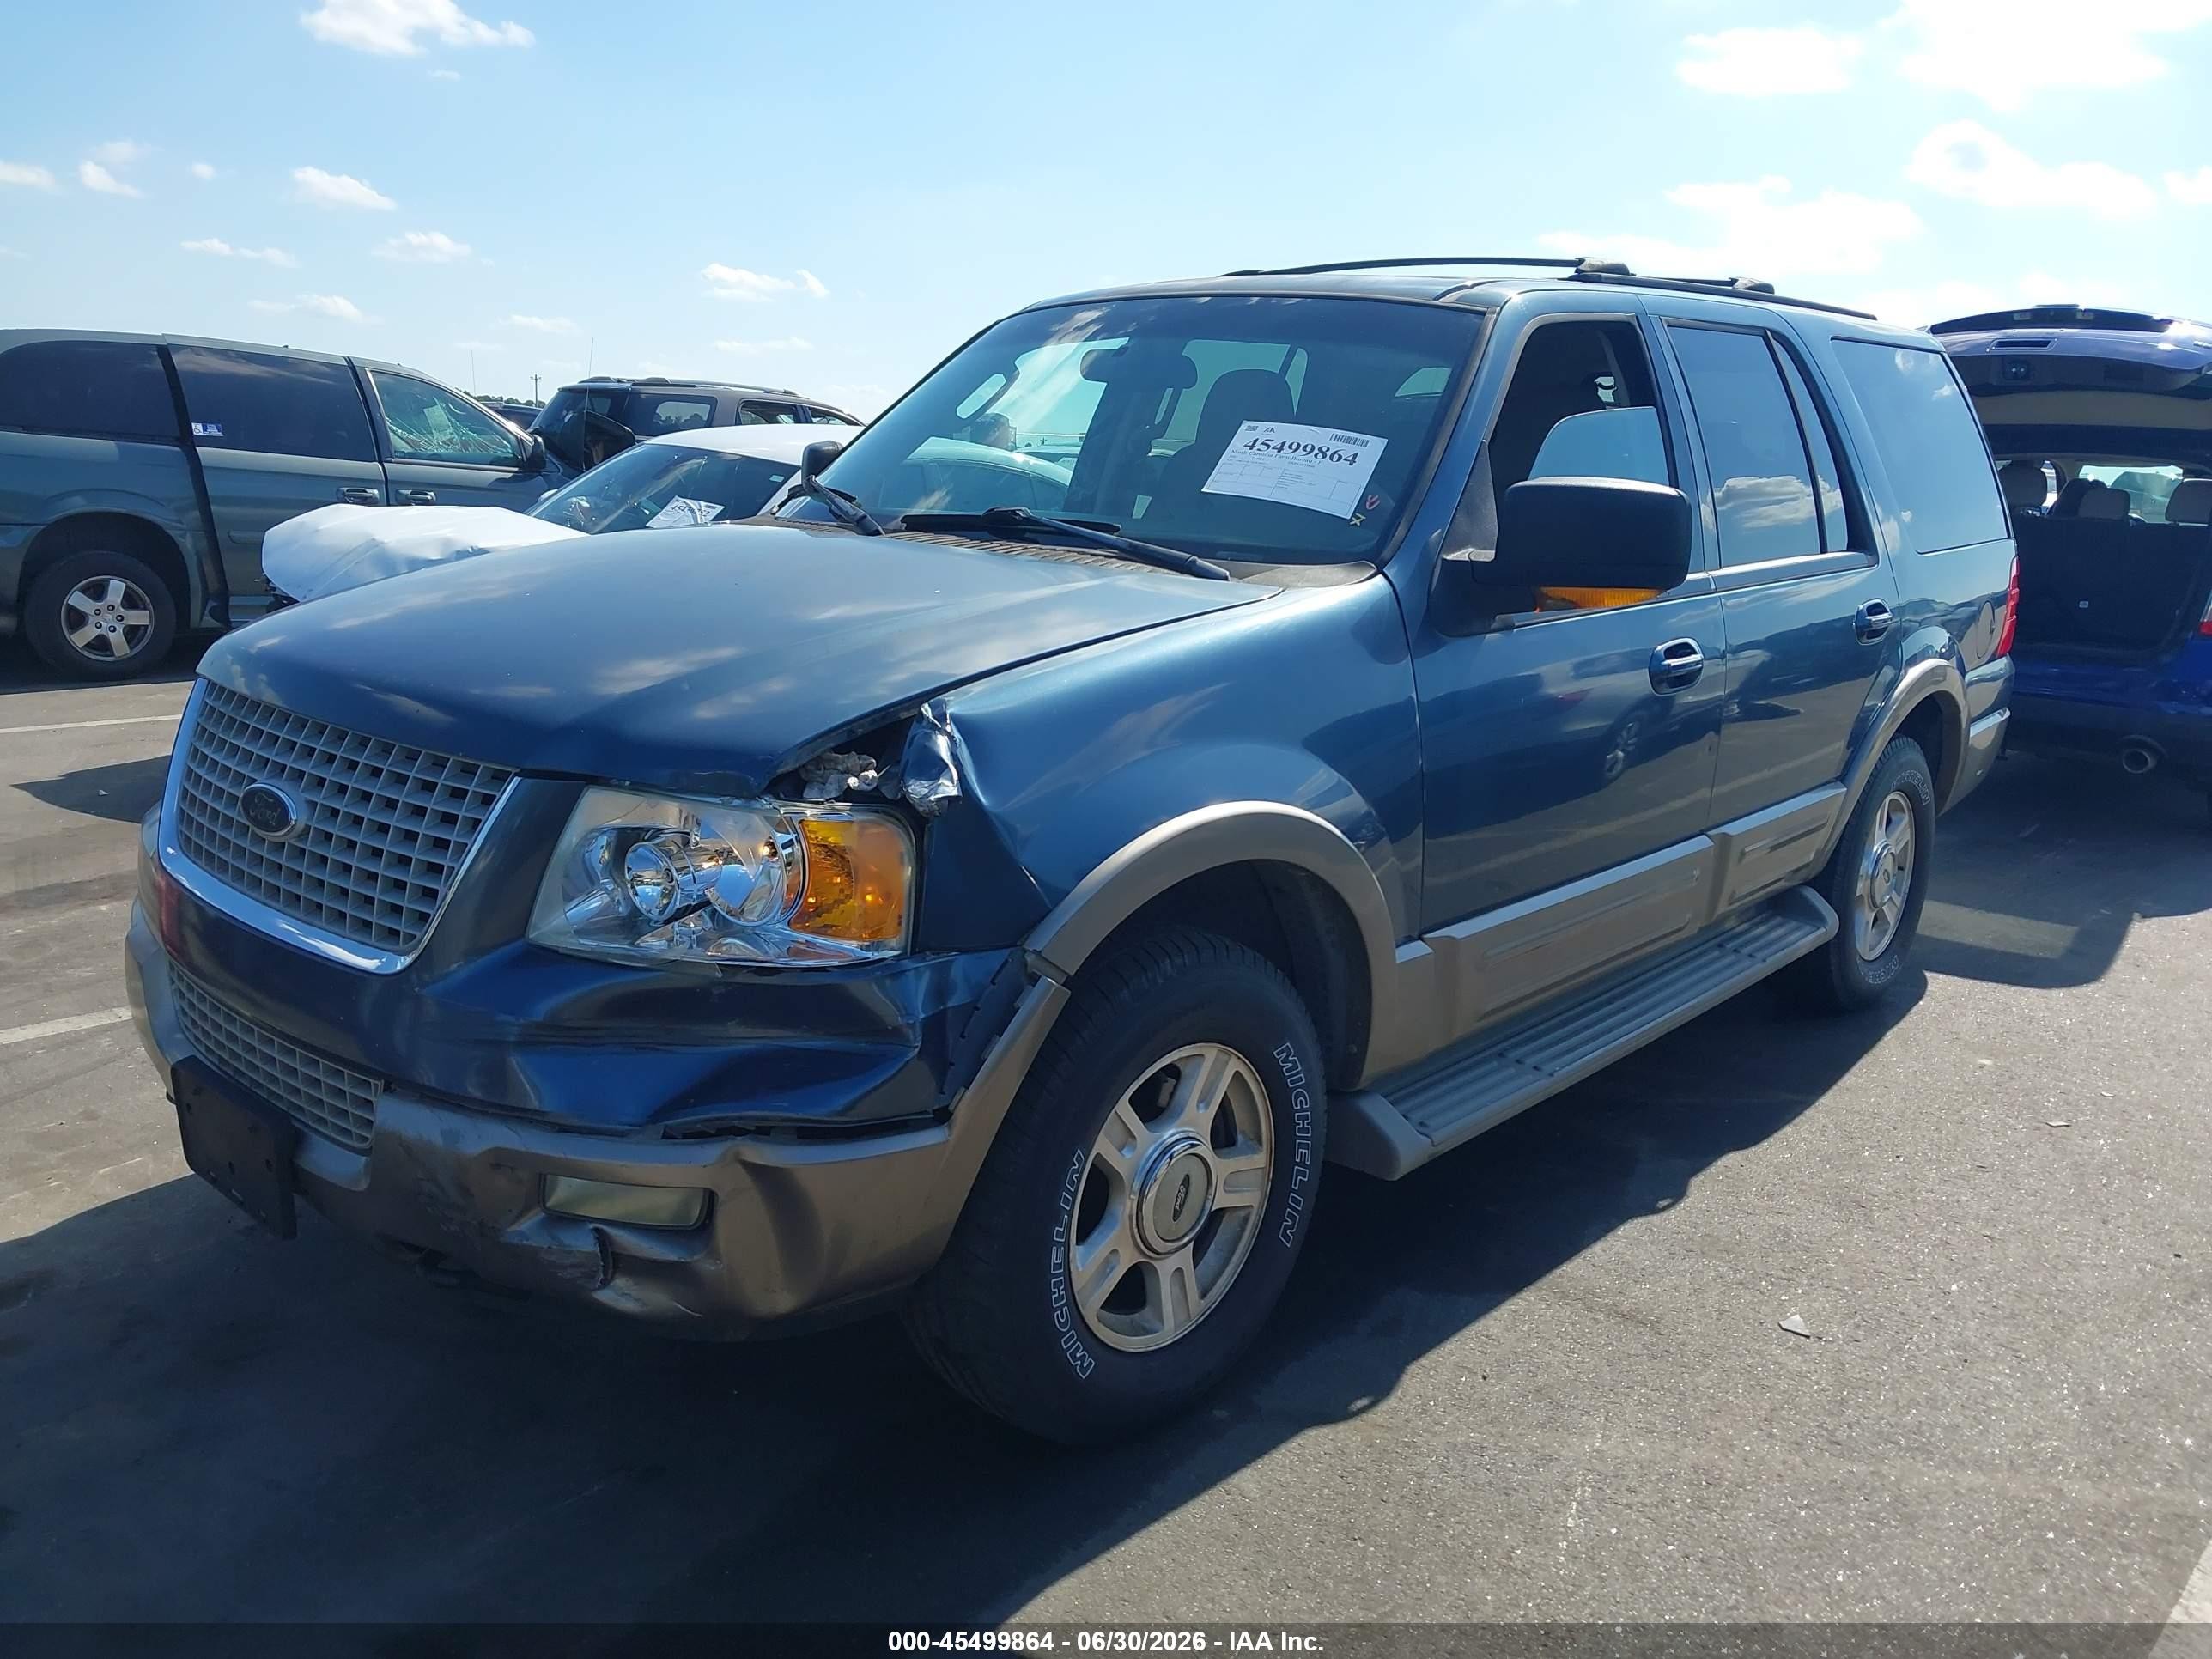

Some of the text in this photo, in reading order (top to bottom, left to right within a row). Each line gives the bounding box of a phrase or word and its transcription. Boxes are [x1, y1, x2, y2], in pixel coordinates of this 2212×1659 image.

[1243, 437, 1359, 466] 45499864
[250, 792, 282, 826] Ford
[1273, 1042, 1312, 1248] MICHELIN
[1050, 1147, 1095, 1379] MICHELIN
